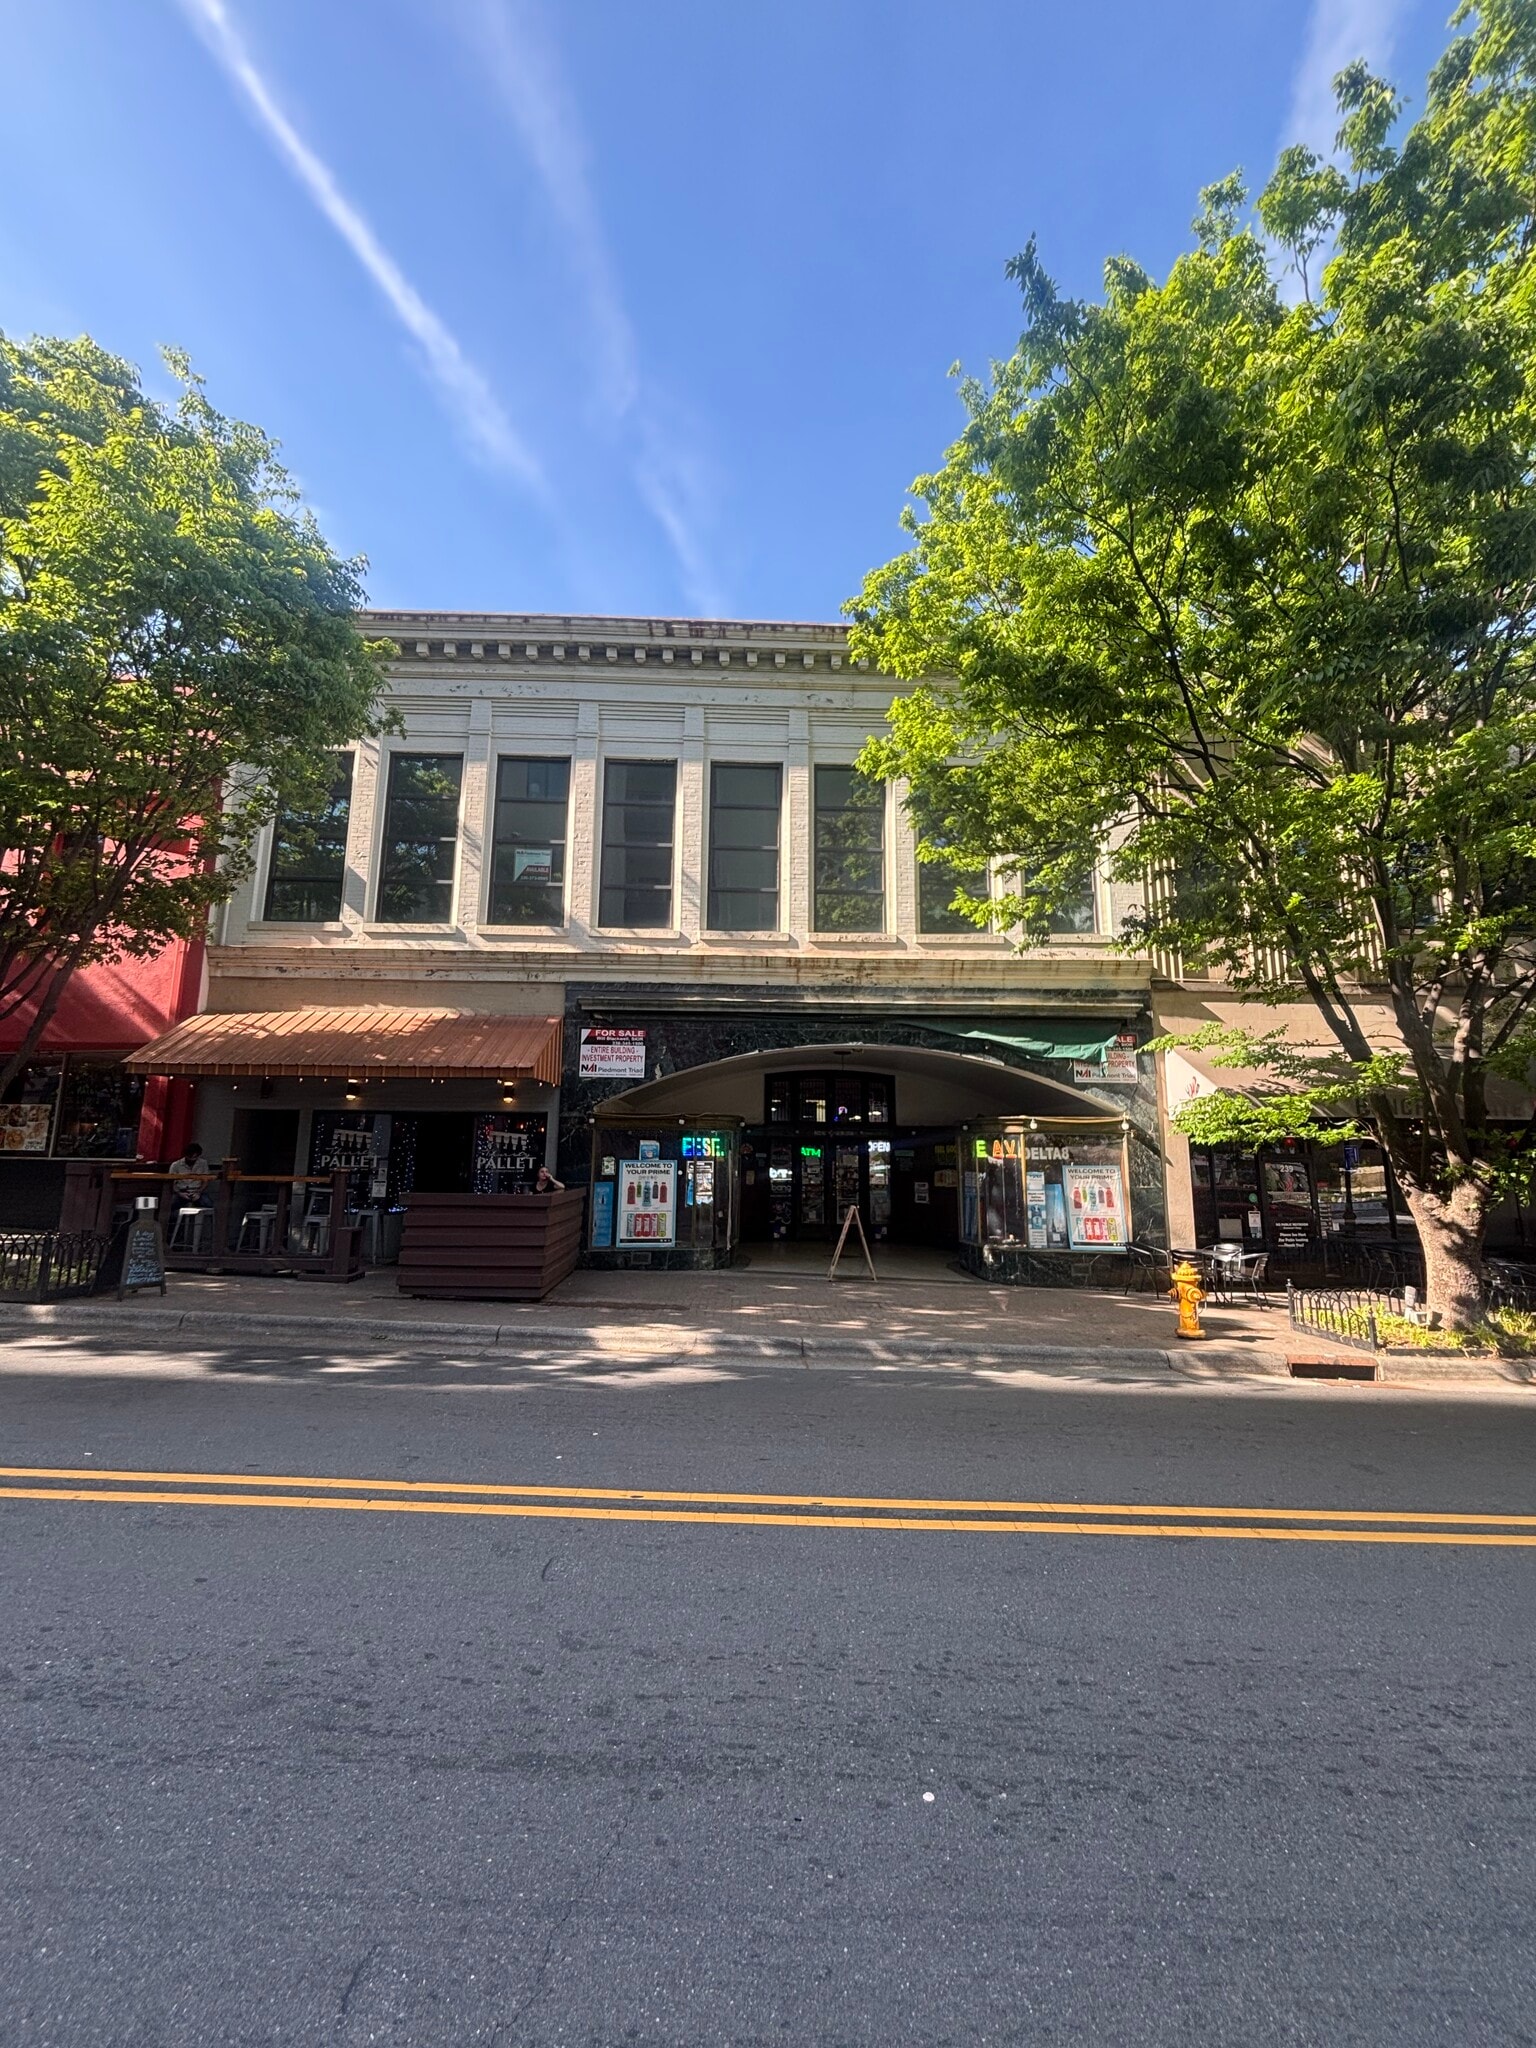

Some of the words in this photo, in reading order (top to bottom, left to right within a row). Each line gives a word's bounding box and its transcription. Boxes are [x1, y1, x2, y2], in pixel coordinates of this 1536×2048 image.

[595, 1029, 616, 1037] FOR
[1116, 1035, 1135, 1043] ALE
[590, 1046, 610, 1054] ENTIRE
[610, 1046, 635, 1055] BUILDING
[581, 1054, 615, 1062] INVESTMENT
[615, 1055, 644, 1063] PROPERTY
[581, 1063, 598, 1073] NAI
[1075, 1068, 1092, 1078] NAI
[801, 1146, 821, 1158] ATM
[320, 1154, 382, 1168] PALLET
[476, 1156, 537, 1169] PALLET
[1280, 1164, 1294, 1173] 239
